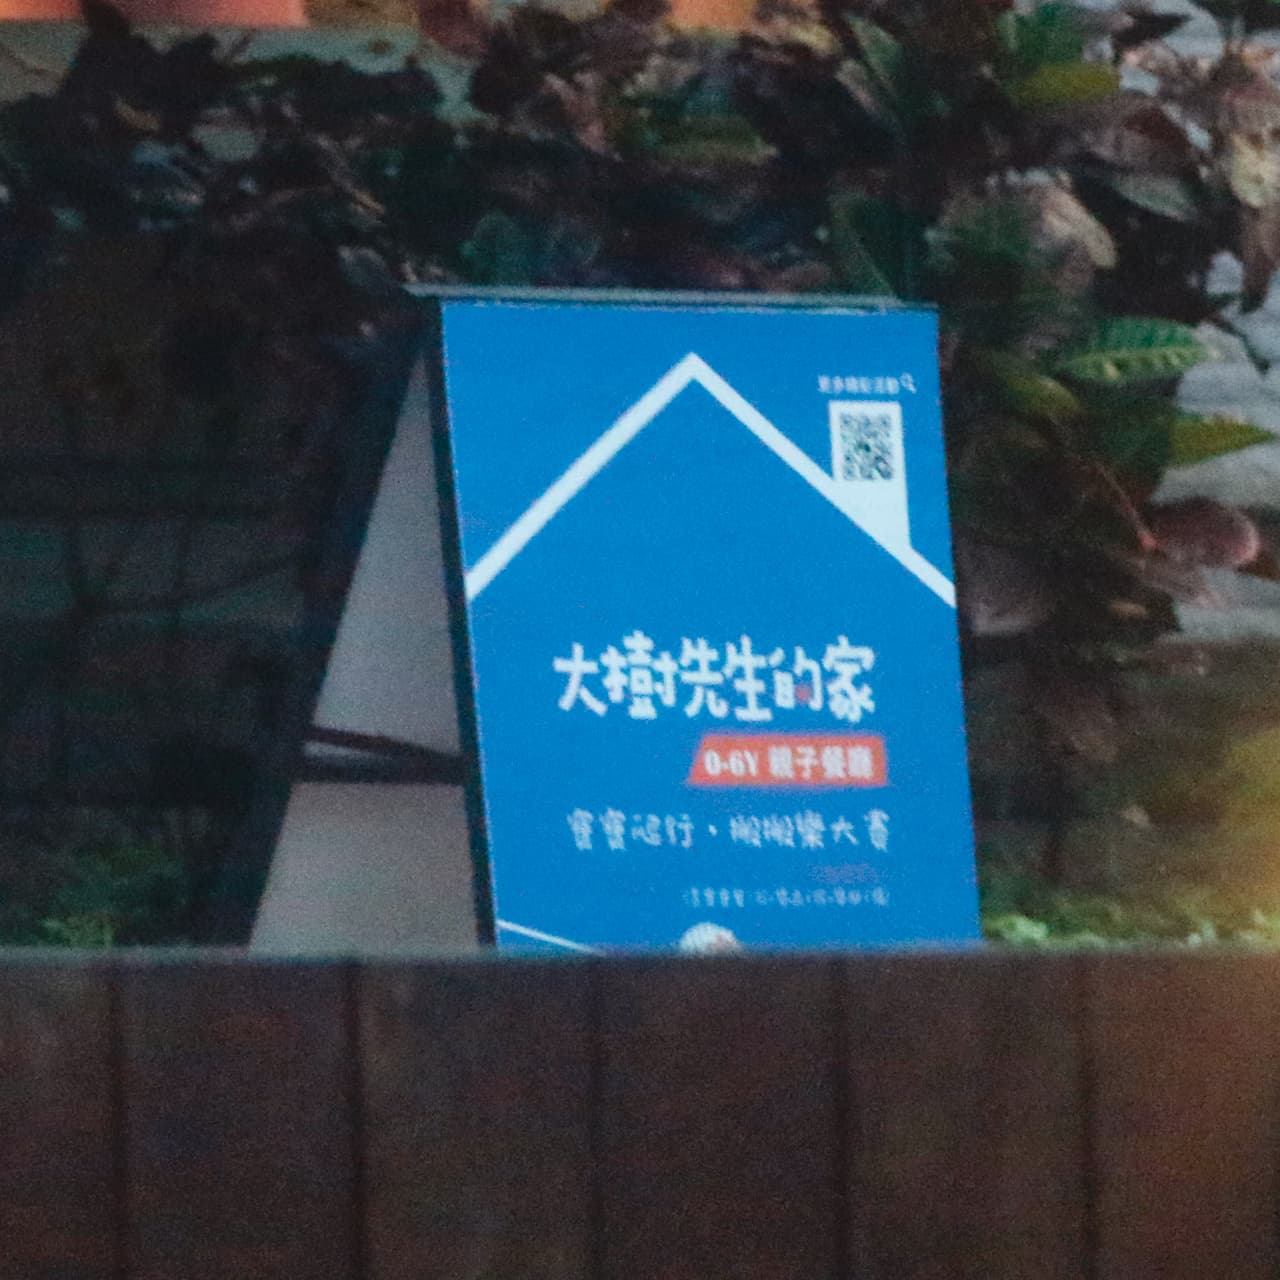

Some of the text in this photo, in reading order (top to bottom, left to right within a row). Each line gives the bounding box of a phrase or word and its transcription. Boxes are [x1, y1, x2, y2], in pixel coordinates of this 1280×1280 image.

[553, 630, 876, 723] 大樹先生的家
[704, 749, 758, 777] 0-6Y
